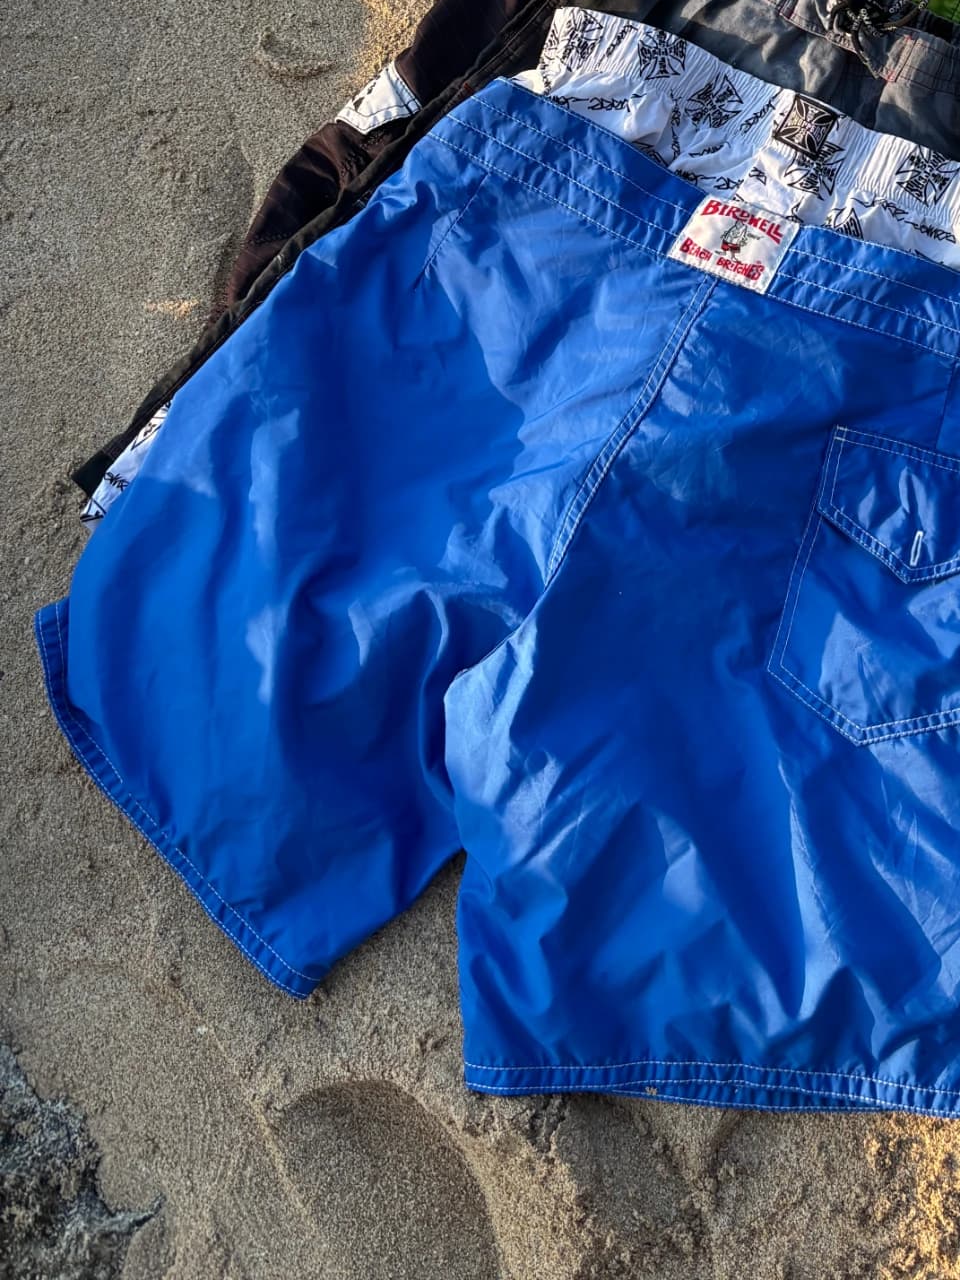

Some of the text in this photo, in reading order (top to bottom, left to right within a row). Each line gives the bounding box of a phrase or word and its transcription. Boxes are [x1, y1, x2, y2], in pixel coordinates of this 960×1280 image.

[700, 199, 784, 244] BIRDWELL
[680, 237, 765, 281] BEACH BRITCHES
